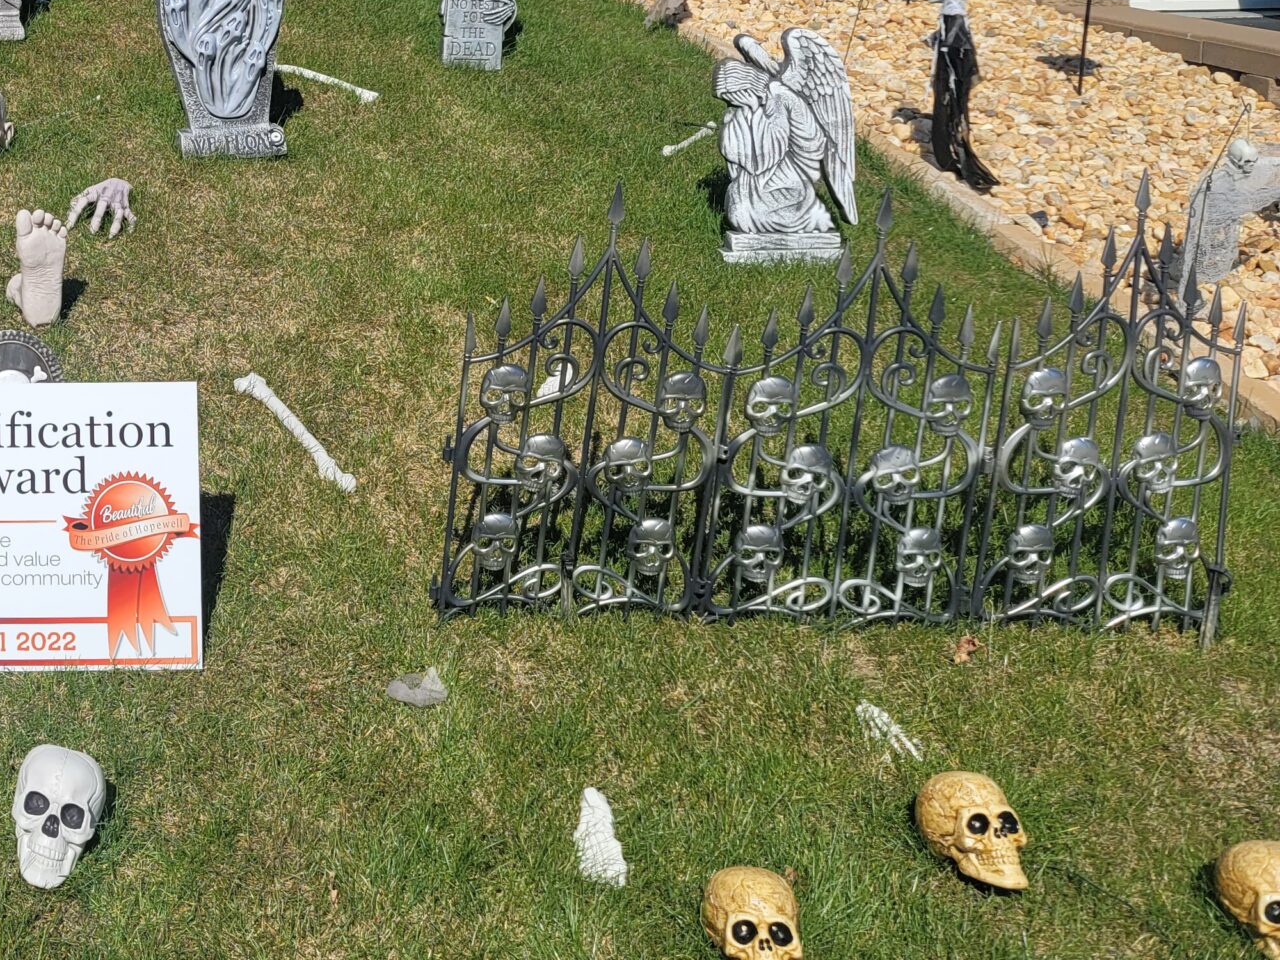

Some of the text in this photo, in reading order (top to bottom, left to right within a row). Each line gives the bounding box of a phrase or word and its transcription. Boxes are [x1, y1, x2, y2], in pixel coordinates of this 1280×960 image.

[450, 0, 497, 11] NO REST
[462, 11, 485, 24] FOR
[460, 27, 486, 39] THE
[450, 41, 497, 57] DEAD
[100, 493, 157, 523] Beautiful
[74, 518, 183, 546] The Pride of Hopewell
[13, 551, 61, 567] value
[0, 570, 104, 589] community
[16, 631, 77, 652] 2022
